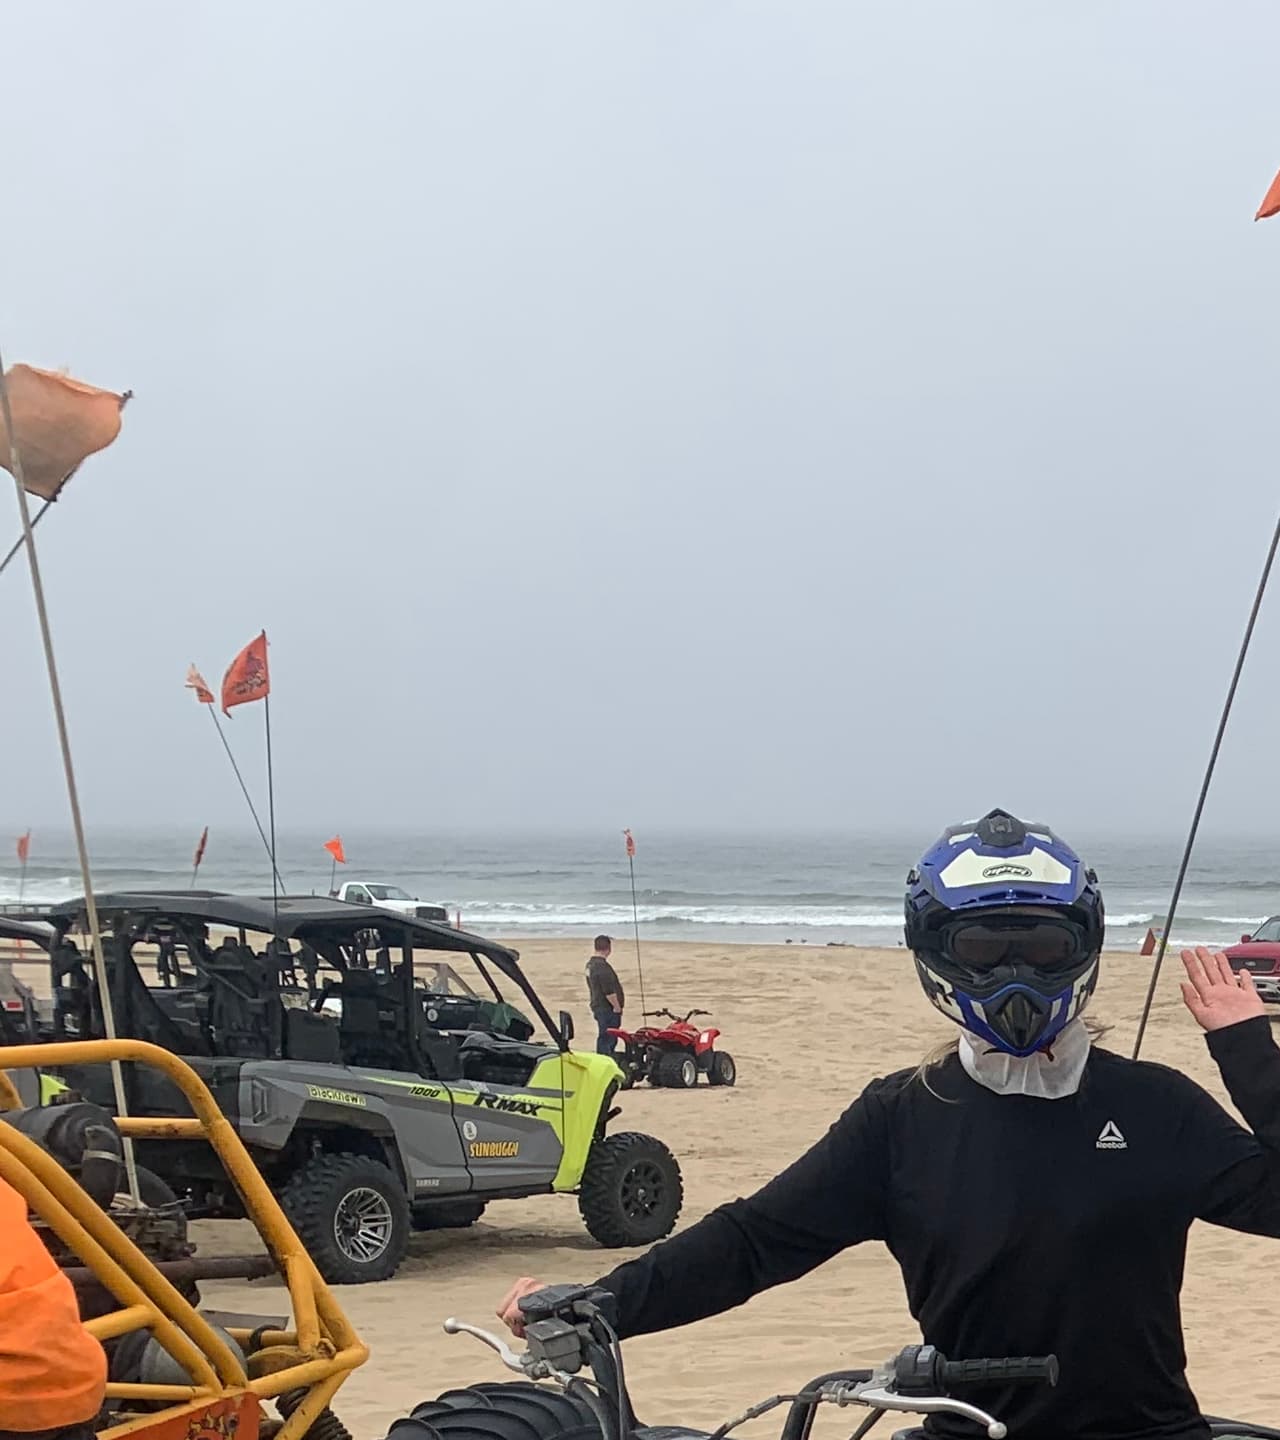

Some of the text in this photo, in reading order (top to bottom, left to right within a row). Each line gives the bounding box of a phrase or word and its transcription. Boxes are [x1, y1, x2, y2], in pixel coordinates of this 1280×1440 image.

[410, 1086, 440, 1098] 1000
[473, 1091, 542, 1116] RMAX
[469, 1141, 519, 1157] SUNBUGGY
